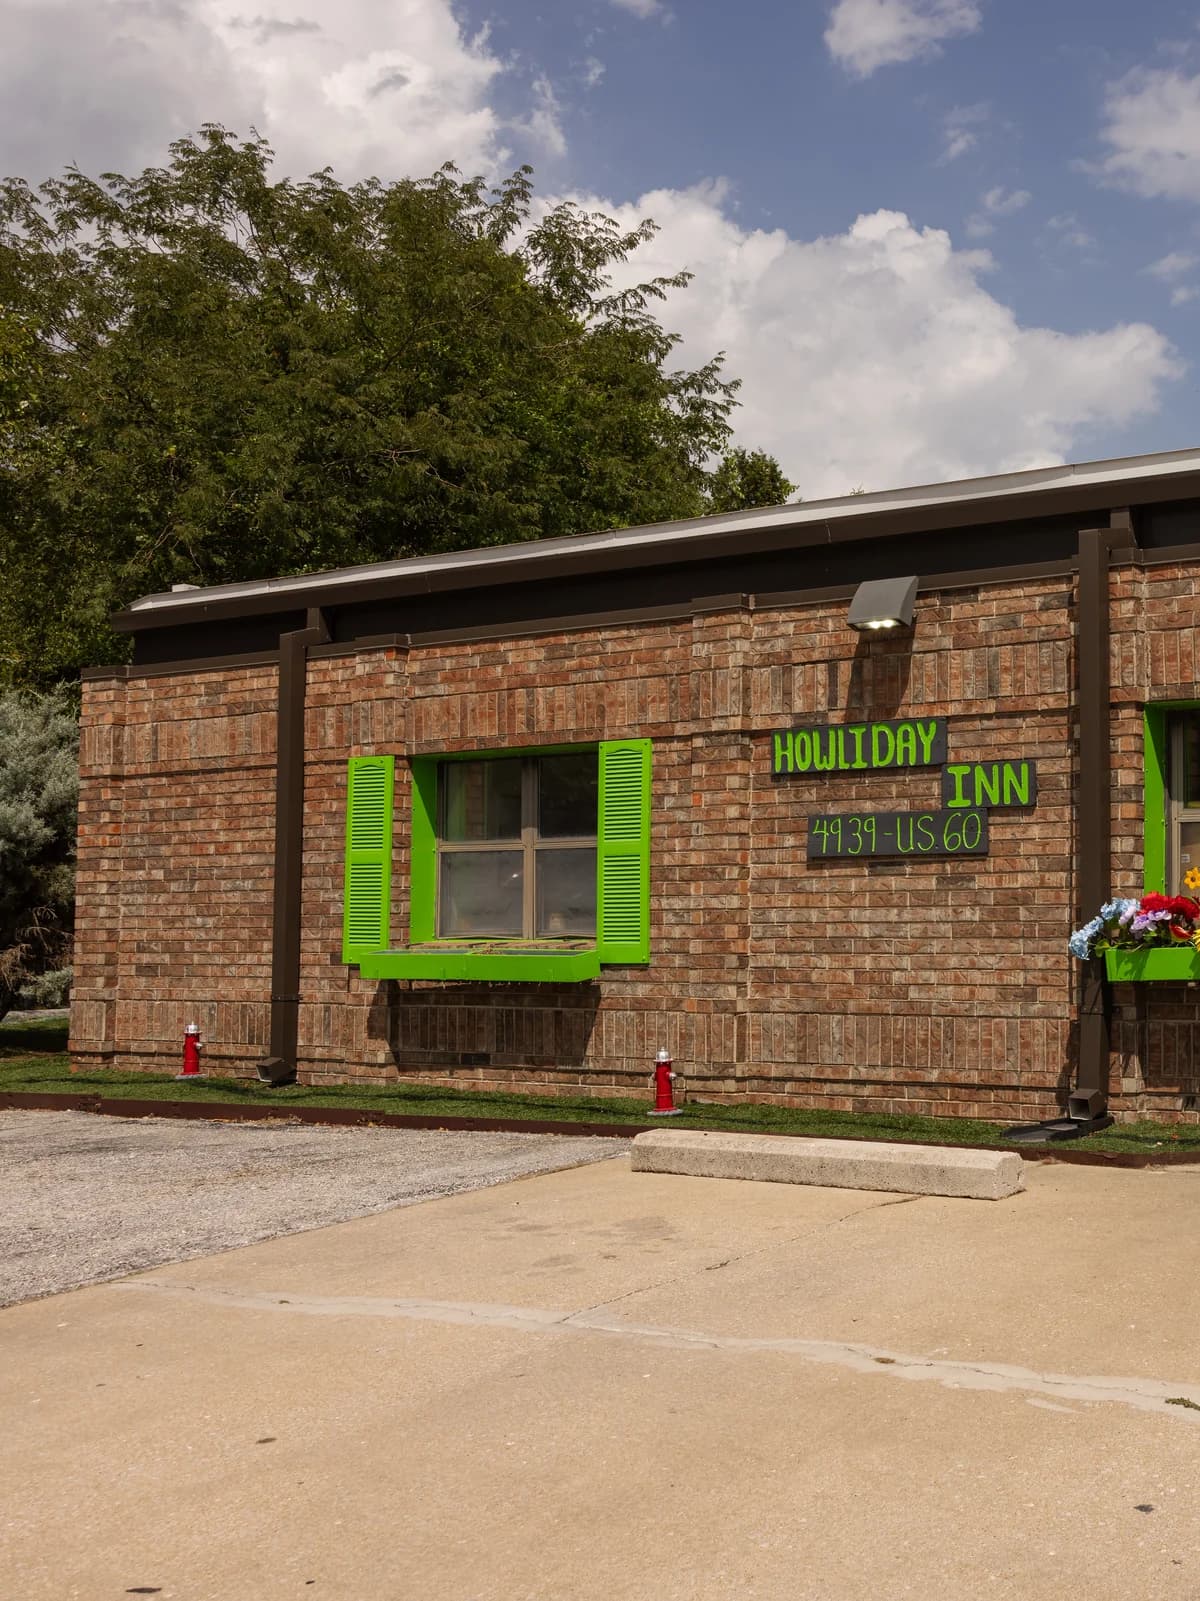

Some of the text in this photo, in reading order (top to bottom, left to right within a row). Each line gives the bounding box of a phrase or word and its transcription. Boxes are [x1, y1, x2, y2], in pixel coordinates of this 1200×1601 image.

[774, 720, 937, 772] HOWLIDAY
[947, 762, 1029, 808] INN
[943, 812, 982, 852] 60
